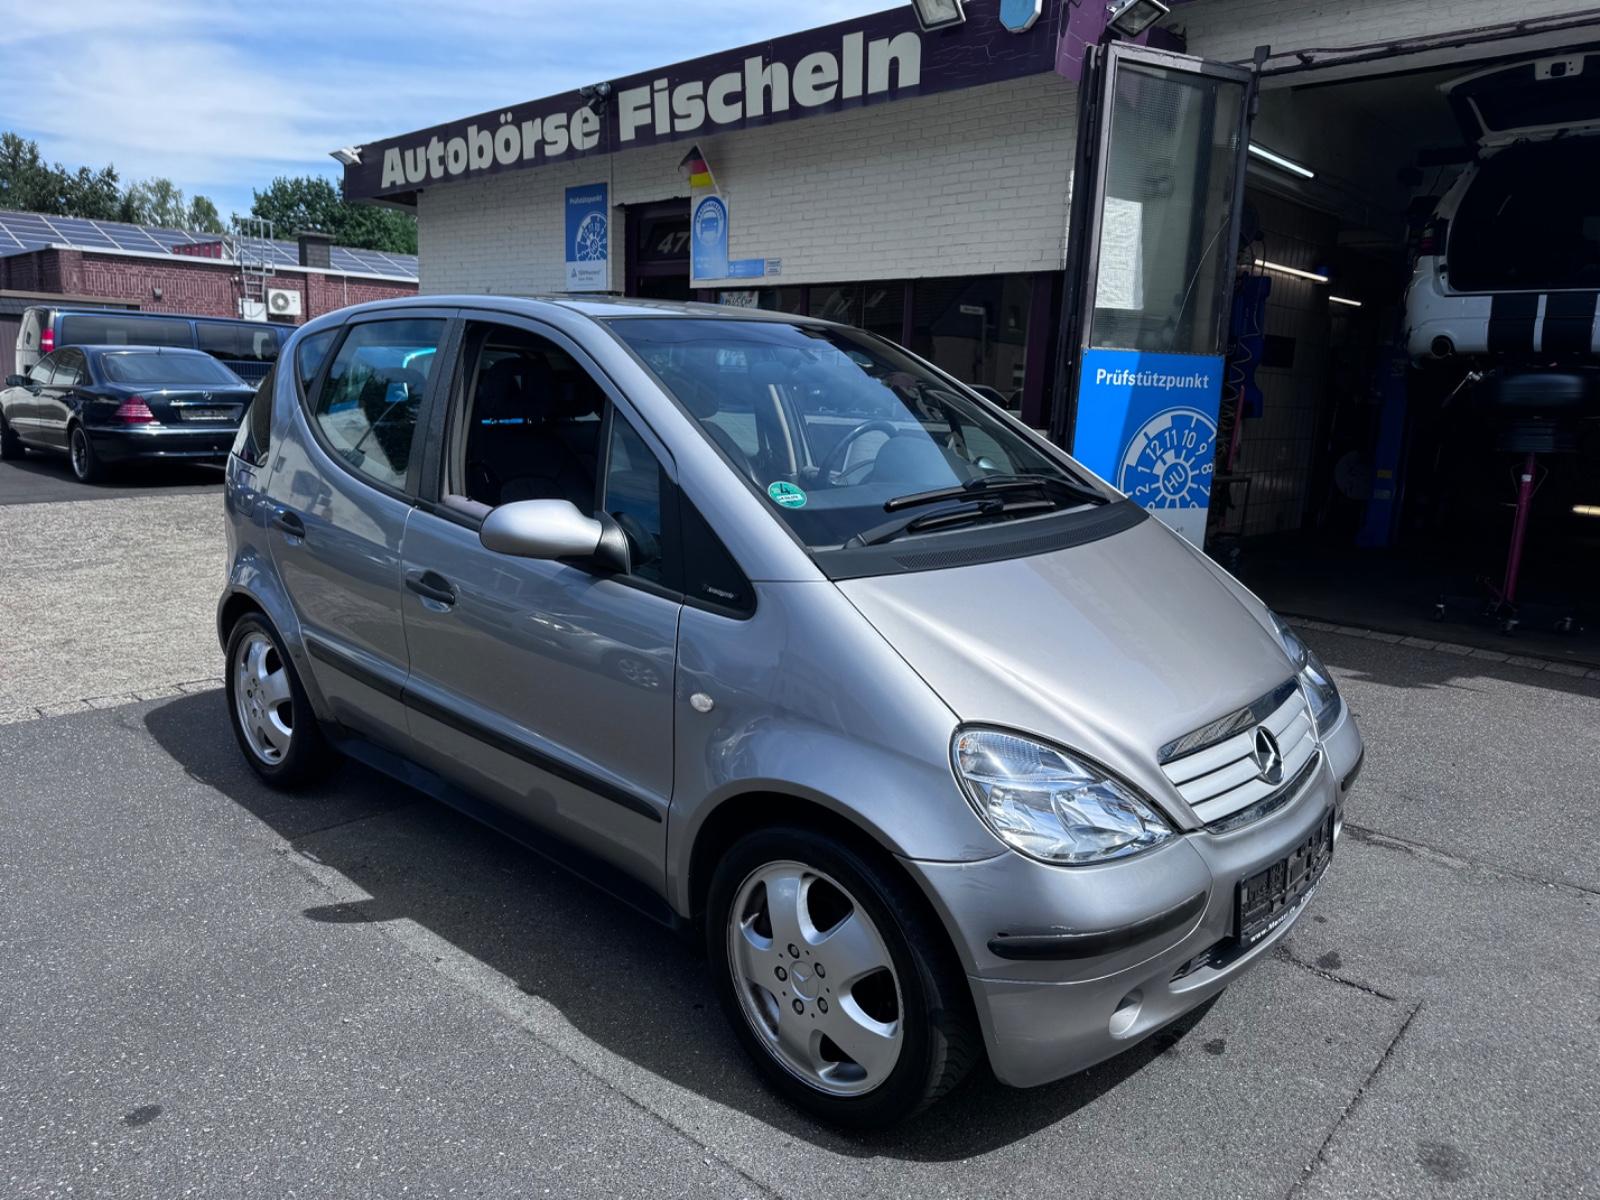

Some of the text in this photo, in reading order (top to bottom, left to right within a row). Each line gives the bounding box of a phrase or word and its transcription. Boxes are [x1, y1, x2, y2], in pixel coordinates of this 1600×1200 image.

[380, 31, 922, 189] Autobörse Fischeln
[657, 231, 691, 254] 47
[1096, 368, 1209, 390] Prüfstützpunkt
[1145, 440, 1164, 460] 12
[1164, 429, 1178, 447] 11
[1182, 429, 1197, 448] 10
[1201, 463, 1213, 475] 8
[1164, 466, 1186, 493] HU
